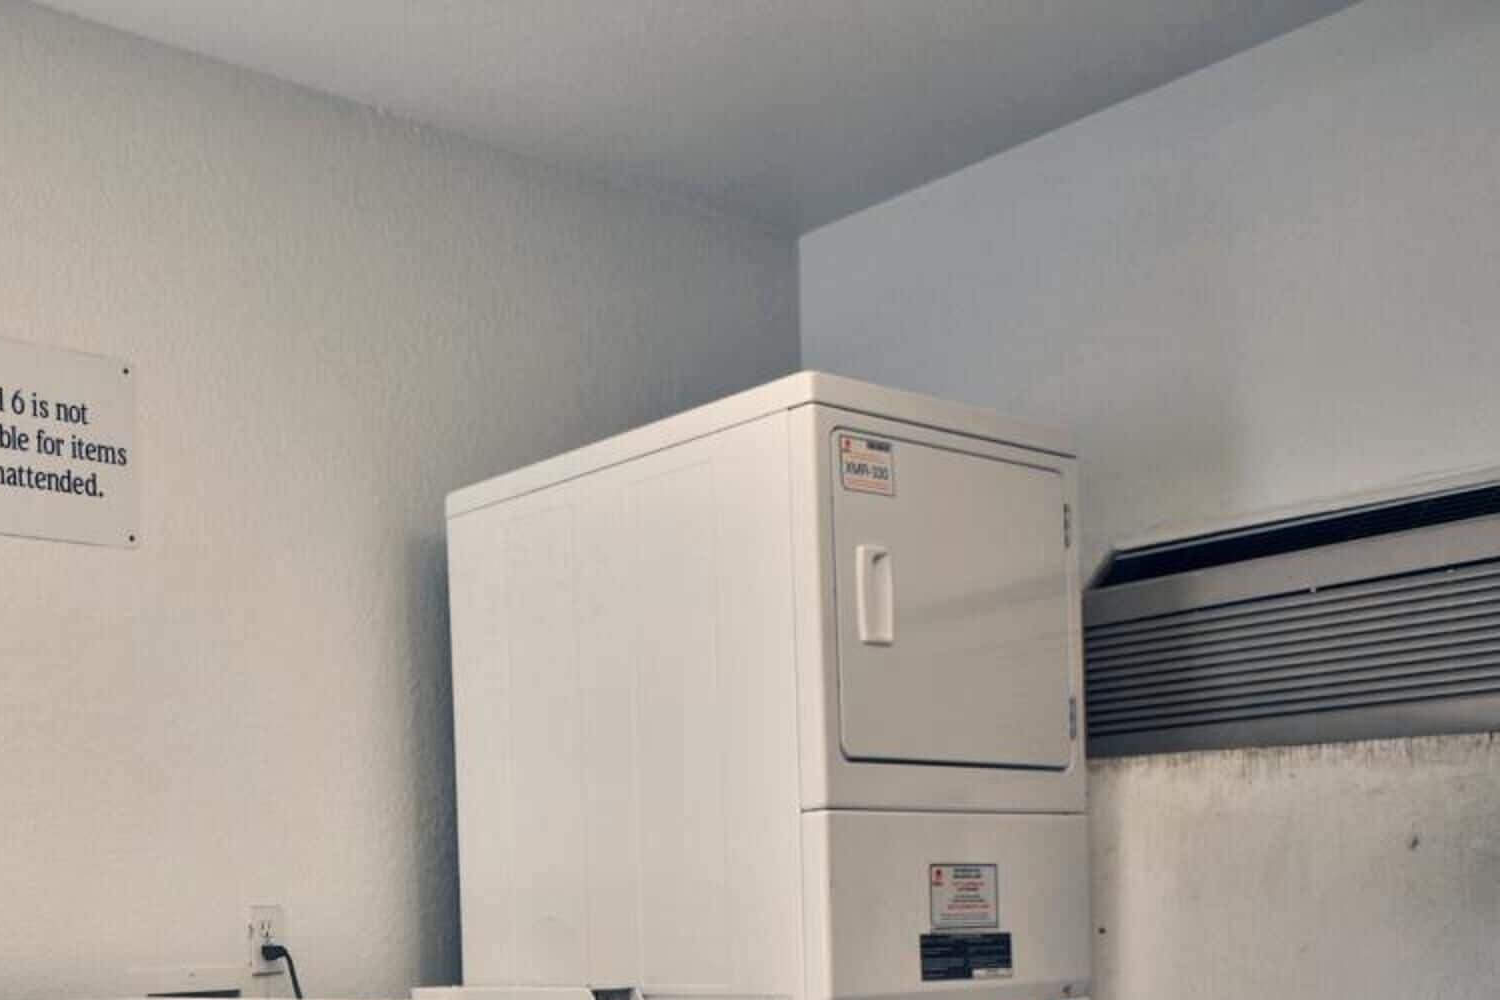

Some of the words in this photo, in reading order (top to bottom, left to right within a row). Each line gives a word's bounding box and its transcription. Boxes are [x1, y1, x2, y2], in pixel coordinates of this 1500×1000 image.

[11, 390, 25, 415] 6
[32, 393, 49, 418] is
[56, 402, 89, 424] not
[36, 430, 65, 457] for
[71, 435, 128, 465] items
